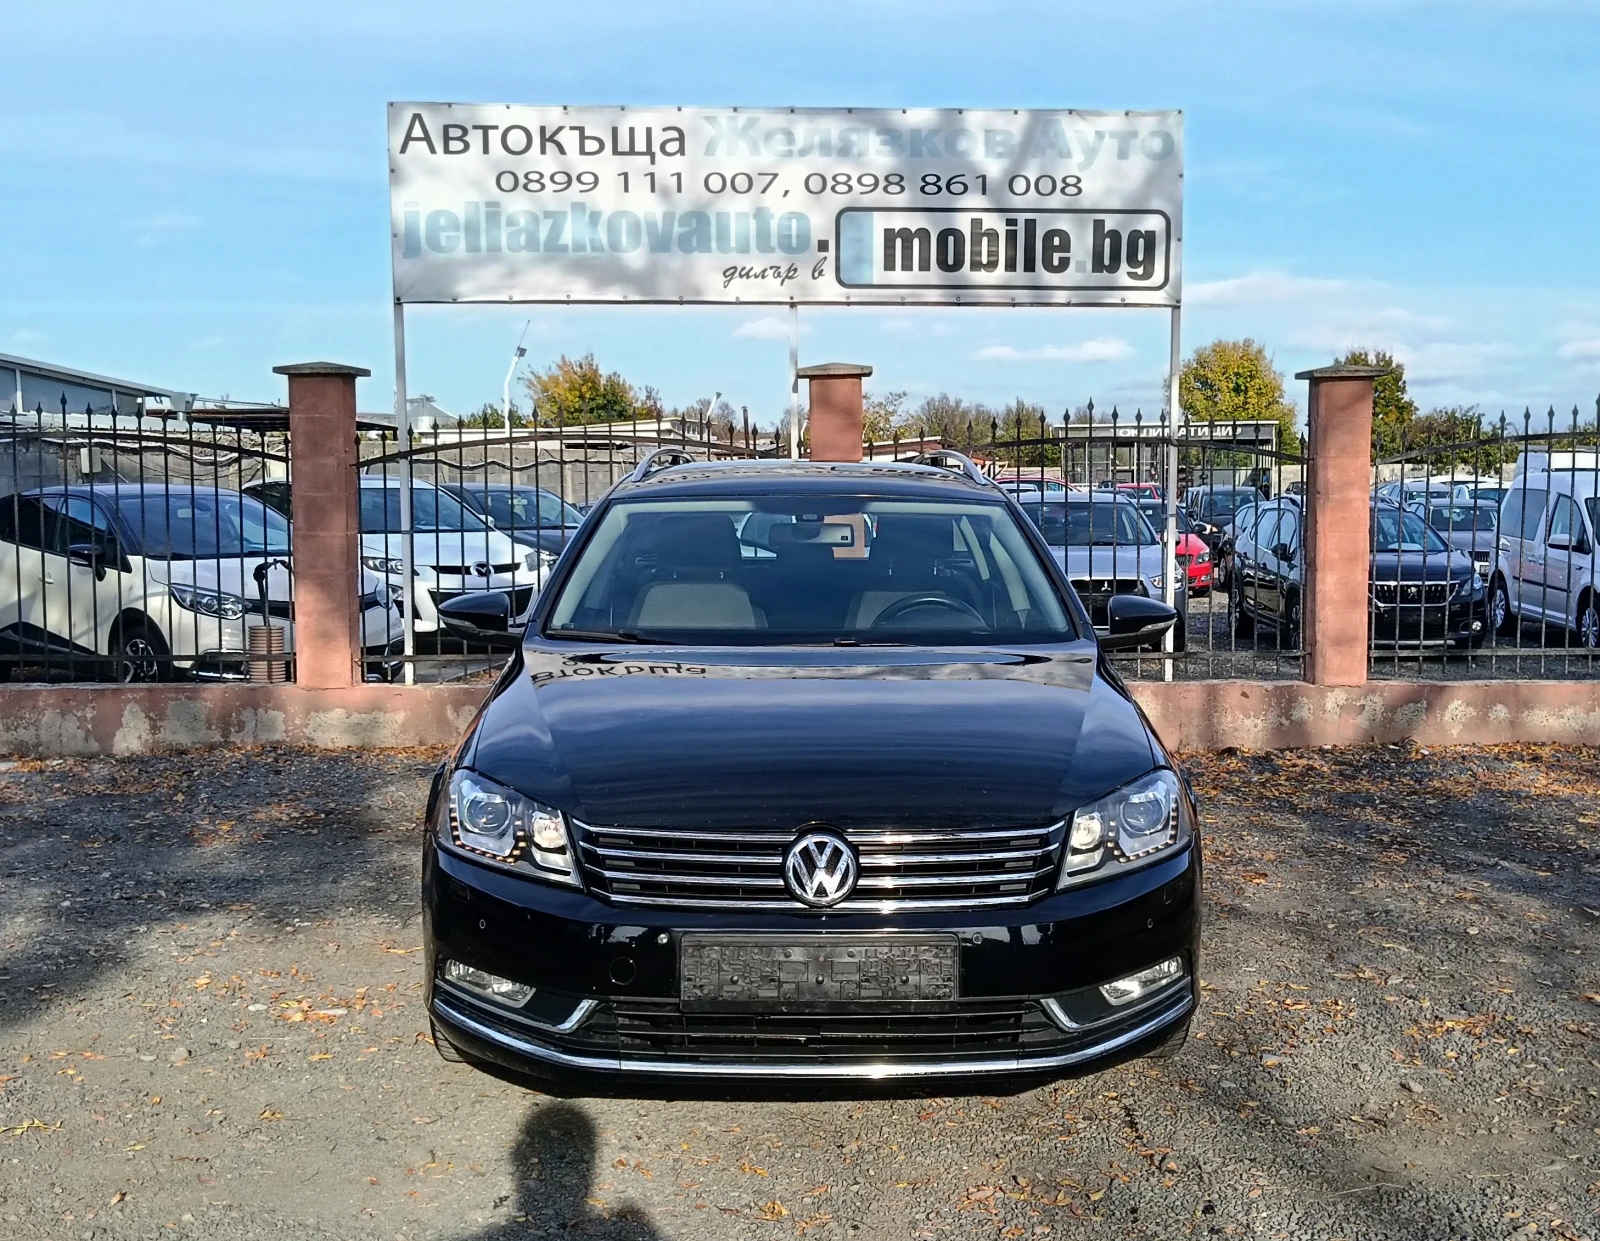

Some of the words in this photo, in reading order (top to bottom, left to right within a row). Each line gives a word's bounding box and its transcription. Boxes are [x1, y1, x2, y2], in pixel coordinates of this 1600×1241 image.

[399, 112, 686, 165] Автокъща
[702, 115, 1017, 161] Желязков
[1031, 118, 1175, 172] Ауто
[495, 170, 600, 194] 0899
[616, 171, 683, 194] 111
[703, 172, 791, 198] 007,
[804, 172, 906, 196] 0898
[919, 173, 988, 196] 861
[1007, 174, 1083, 197] 008
[722, 262, 800, 289] дилър
[811, 255, 828, 281] в
[883, 217, 1157, 281] mobile.bg
[788, 837, 855, 903] VW
